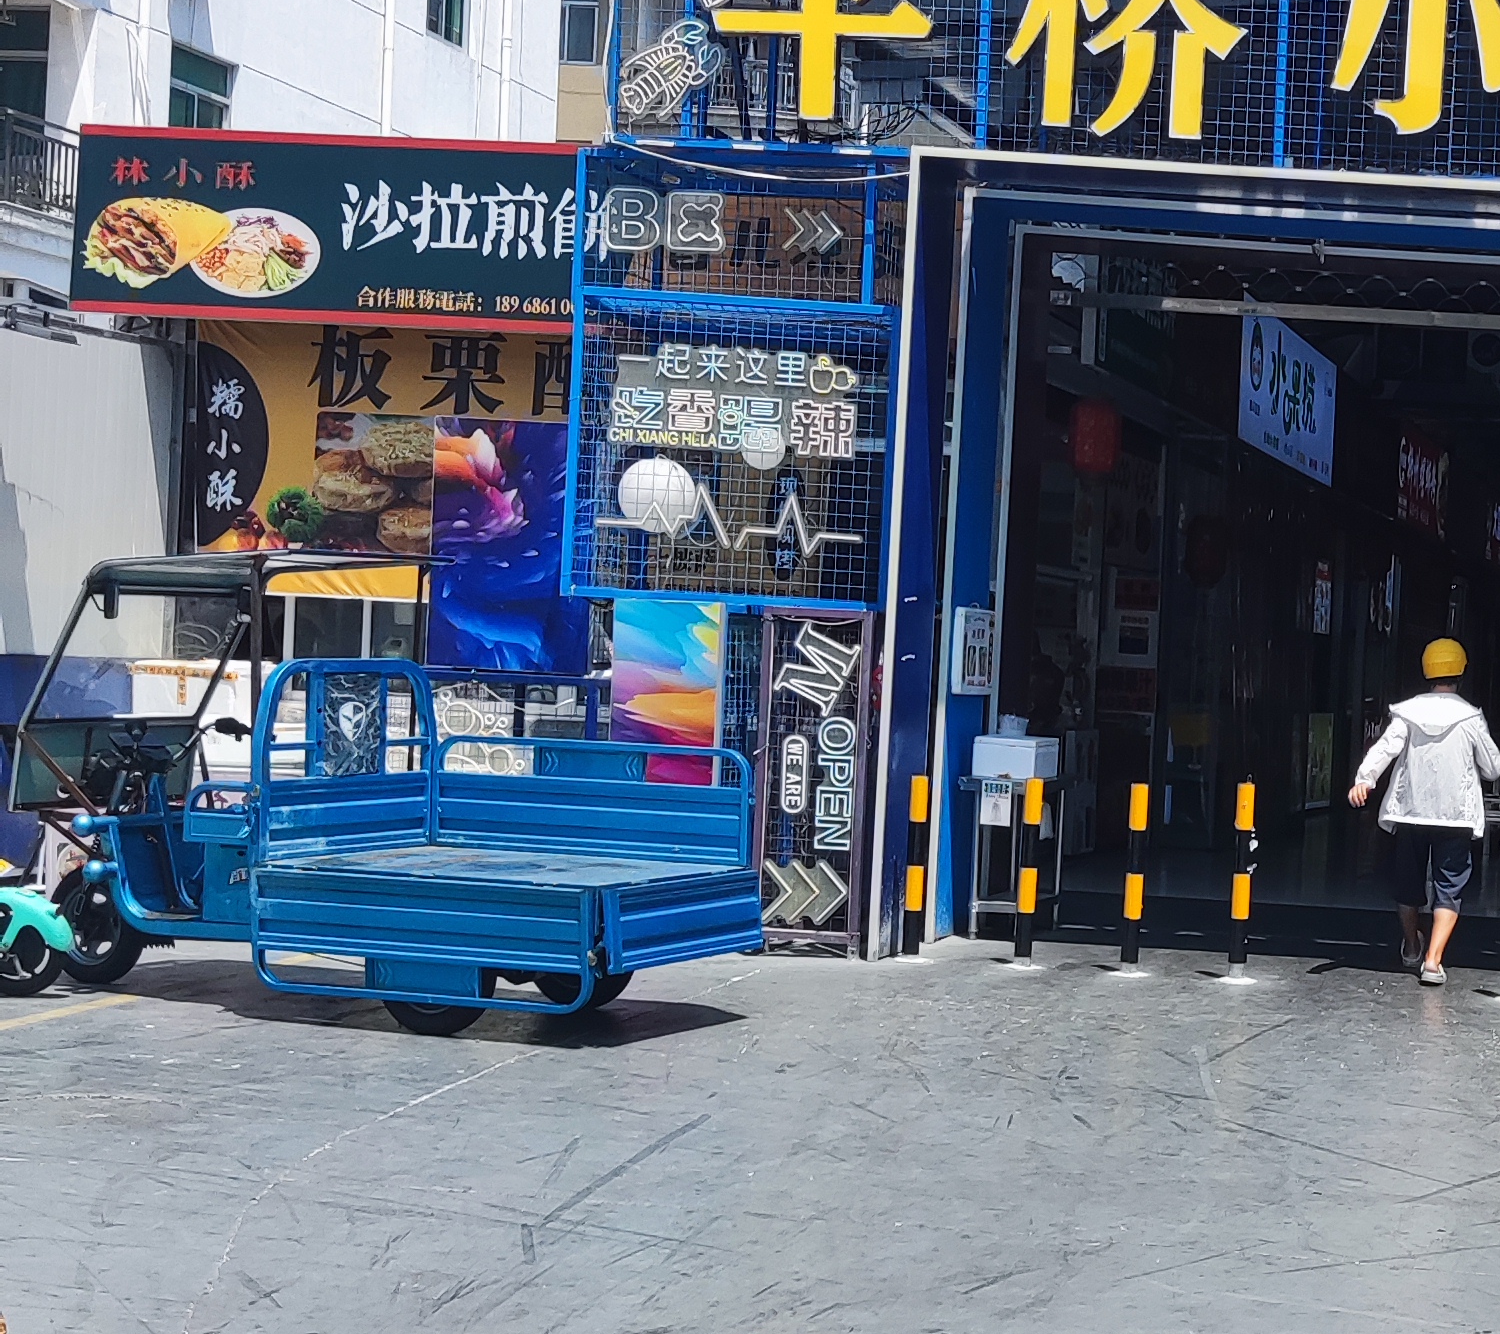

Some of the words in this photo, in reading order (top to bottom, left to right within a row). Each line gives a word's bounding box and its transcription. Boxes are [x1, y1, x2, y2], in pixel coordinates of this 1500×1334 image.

[109, 156, 256, 191] 林小酥
[495, 295, 520, 312] 189
[522, 296, 556, 314] 6861
[618, 344, 807, 387] 一起来这里
[610, 430, 633, 443] CHI
[636, 430, 679, 445] XIANG
[612, 386, 855, 457] 吃香喝辣
[207, 378, 246, 512] 糯小酥
[786, 742, 802, 766] WE
[785, 772, 802, 808] ARE
[814, 717, 856, 851] OPEN
